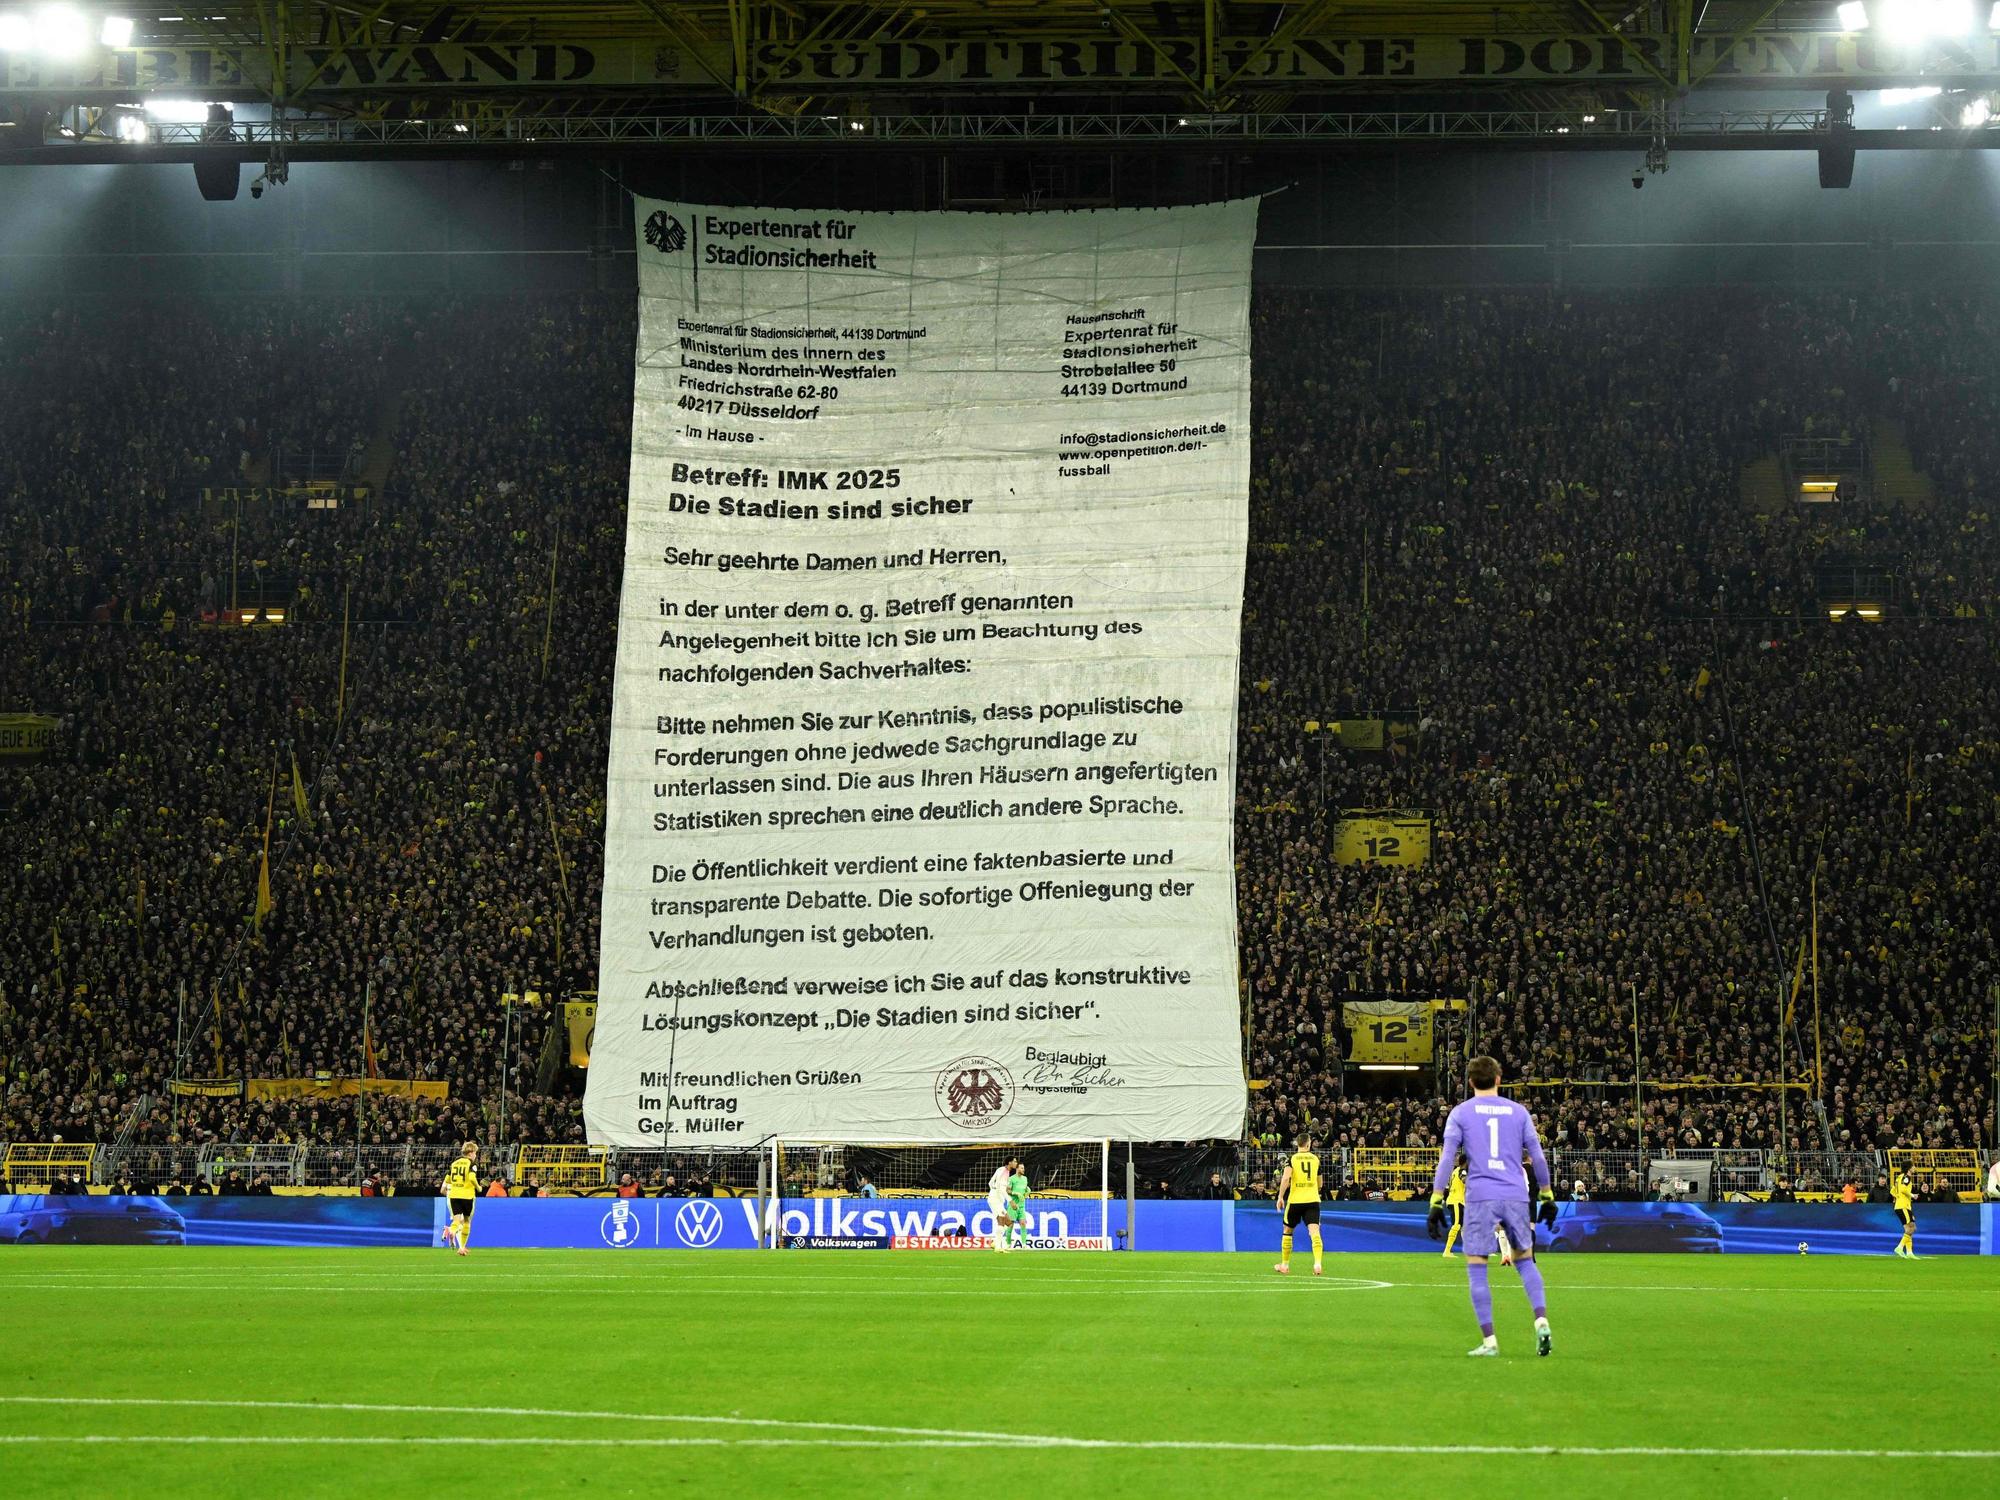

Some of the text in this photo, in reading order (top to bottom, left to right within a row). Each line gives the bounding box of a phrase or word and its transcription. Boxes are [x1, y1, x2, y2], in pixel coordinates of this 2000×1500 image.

[303, 44, 595, 85] WAND
[756, 38, 1415, 80] SÜDTRIBÜNE
[705, 216, 857, 240] Expertenrat für
[704, 243, 877, 270] Stadionsicherheit
[1066, 308, 1146, 325] Hausanschrift
[677, 319, 927, 341] Expertenrat für Stadionsicherheit, 44139 Dortmund
[1063, 322, 1179, 345] Expertenrat für
[679, 336, 886, 361] Ministerium des Innern des
[1062, 338, 1198, 359] Stadionsicherheit
[680, 353, 897, 380] Landes Nordrhein-Westfalen
[1061, 359, 1176, 379] Strobelallee 50
[678, 373, 839, 400] Friedrichstraße 62-80
[1060, 375, 1188, 398] 44139 Dortmund
[677, 394, 821, 420] 40217 Düsseldorf
[685, 424, 703, 439] Im
[706, 427, 755, 444] Hause
[1059, 421, 1227, 448] info@stadionsicherheit.de
[671, 462, 901, 491] Betreff: IMK 2025
[1057, 463, 1111, 477] fussball
[668, 492, 974, 520] Die Stadien sind sicher
[663, 546, 1007, 573] Sehr geehrte Damen und Herren,
[659, 592, 1074, 624] in der unter dem o. g. Betreff genannten
[658, 630, 810, 655] Angelegenheit
[814, 630, 861, 649] bitte
[904, 628, 937, 647] Sie
[942, 627, 976, 642] um
[982, 622, 1099, 641] Beachtung
[1104, 620, 1143, 635] des
[658, 656, 972, 687] nachfolgenden Sachverhaltes:
[656, 695, 1184, 736] Bitte nehmen Sie zur Kenntnis, dass populistische
[654, 731, 1138, 768] Forderungen ohne jedwede Sachgrundlage zu
[653, 760, 1218, 798] unterlassen sind. Die aus Ihren Häusern angefertigten
[653, 794, 1184, 832] Statistiken sprechen eine deutlich andere Sprache.
[1364, 837, 1400, 857] 12
[652, 848, 1174, 884] Die Öffentlichkeit verdient eine faktenbasierte und
[650, 892, 781, 919] transparente
[786, 890, 872, 910] Debatte.
[878, 888, 913, 908] Die
[918, 885, 1013, 909] sofortige
[1158, 878, 1195, 897] der
[648, 923, 934, 950] Verhandlungen ist geboten.
[645, 965, 1191, 998] Abschließend verweise ich Sie auf das konstruktive
[642, 1009, 819, 1033] Lösungskonzept
[875, 1005, 958, 1028] Stadien
[963, 1002, 1010, 1024] sind
[1368, 1022, 1408, 1043] 12
[1025, 1046, 1107, 1069] Beglaubigt
[640, 1069, 861, 1087] Mit freundlichen Grüßen
[1069, 1066, 1125, 1087] Sicher
[638, 1094, 738, 1113] Im Auftrag
[637, 1117, 744, 1134] Gez. Müller
[976, 1117, 992, 1126] 2025
[1486, 1117, 1499, 1159] 1
[452, 1166, 466, 1182] 24
[1301, 1161, 1311, 1181] 4
[811, 1238, 877, 1248] Volkswagen
[910, 1237, 982, 1248] STRAUSS
[1009, 1239, 1055, 1249] ARGO
